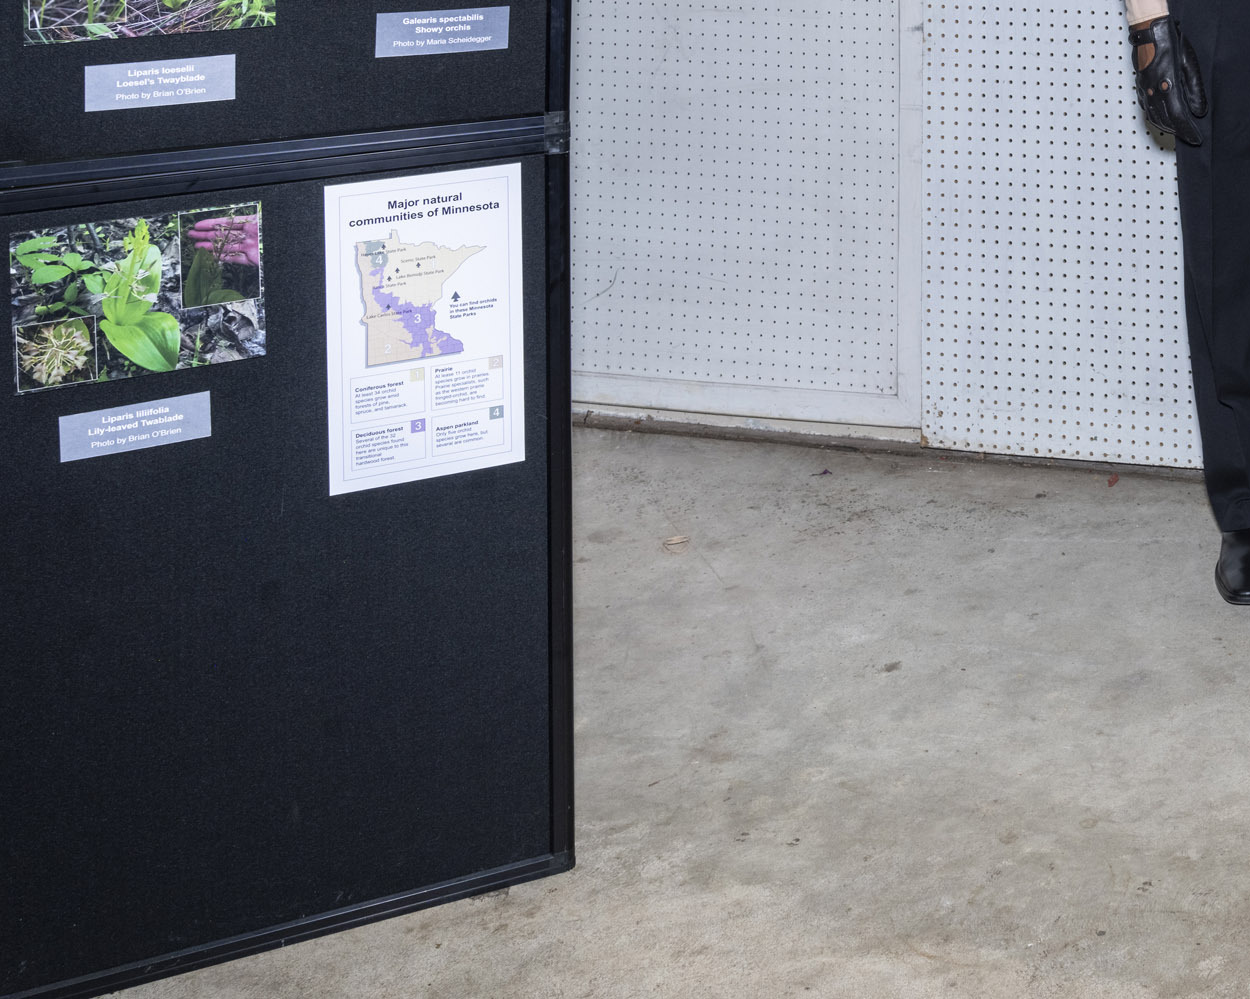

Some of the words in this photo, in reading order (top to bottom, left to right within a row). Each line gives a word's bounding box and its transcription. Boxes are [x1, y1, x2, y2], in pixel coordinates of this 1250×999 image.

[403, 16, 437, 25] Galearis
[439, 14, 484, 24] spectabilis
[415, 26, 443, 34] Showy
[445, 24, 471, 32] orchis
[448, 35, 492, 44] Scheidegger
[128, 68, 159, 77] Liparis
[162, 65, 194, 74] loeselii
[116, 79, 155, 88] Loesel's
[157, 74, 205, 85] Twayblade
[153, 90, 174, 98] Brian
[387, 199, 419, 209] Major
[423, 192, 462, 205] natural
[349, 211, 423, 227] communities
[427, 208, 438, 217] of
[442, 202, 499, 216] Minnesota
[375, 256, 383, 264] 4
[414, 314, 422, 324] 3
[384, 344, 392, 354] 2
[493, 358, 499, 367] 2
[355, 384, 386, 393] Coniferous
[102, 412, 134, 424] Liparis
[136, 407, 170, 418] liliifolia
[493, 408, 500, 417] 4
[88, 421, 138, 436] Lily-leaved
[141, 414, 184, 427] Twablade
[415, 422, 422, 430] 3
[455, 420, 479, 428] parkland
[91, 439, 114, 448] Photo
[116, 437, 126, 445] by
[128, 433, 150, 442] Brian
[152, 427, 182, 438] O'Brien
[356, 430, 385, 438] Deciduous
